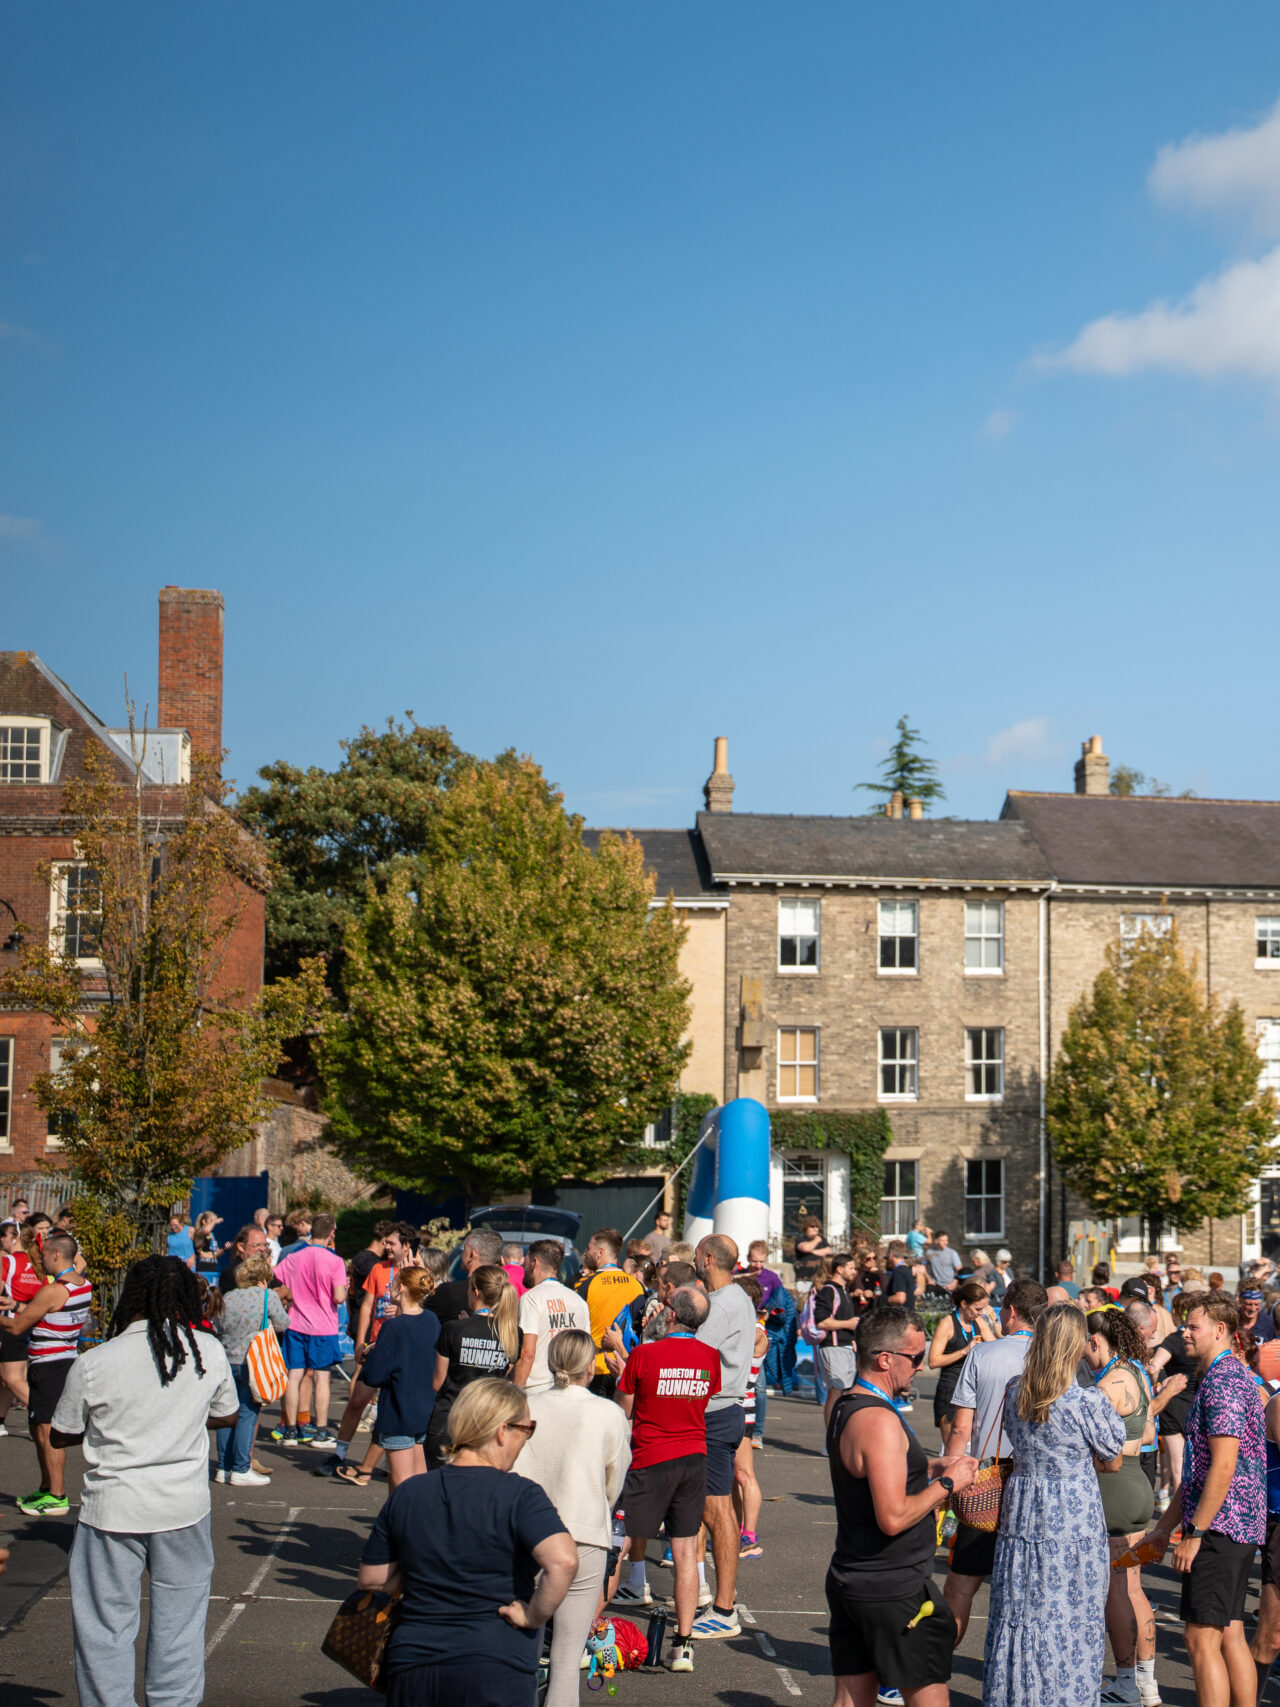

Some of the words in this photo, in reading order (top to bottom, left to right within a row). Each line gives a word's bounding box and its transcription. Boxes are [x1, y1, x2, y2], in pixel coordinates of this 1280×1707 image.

[612, 1276, 629, 1284] Hill
[546, 1298, 567, 1313] RUN
[548, 1312, 577, 1329] WALK
[461, 1337, 498, 1350] MORETON
[659, 1368, 695, 1379] MORETON
[695, 1369, 711, 1381] HALL
[656, 1379, 710, 1397] RUNNERS
